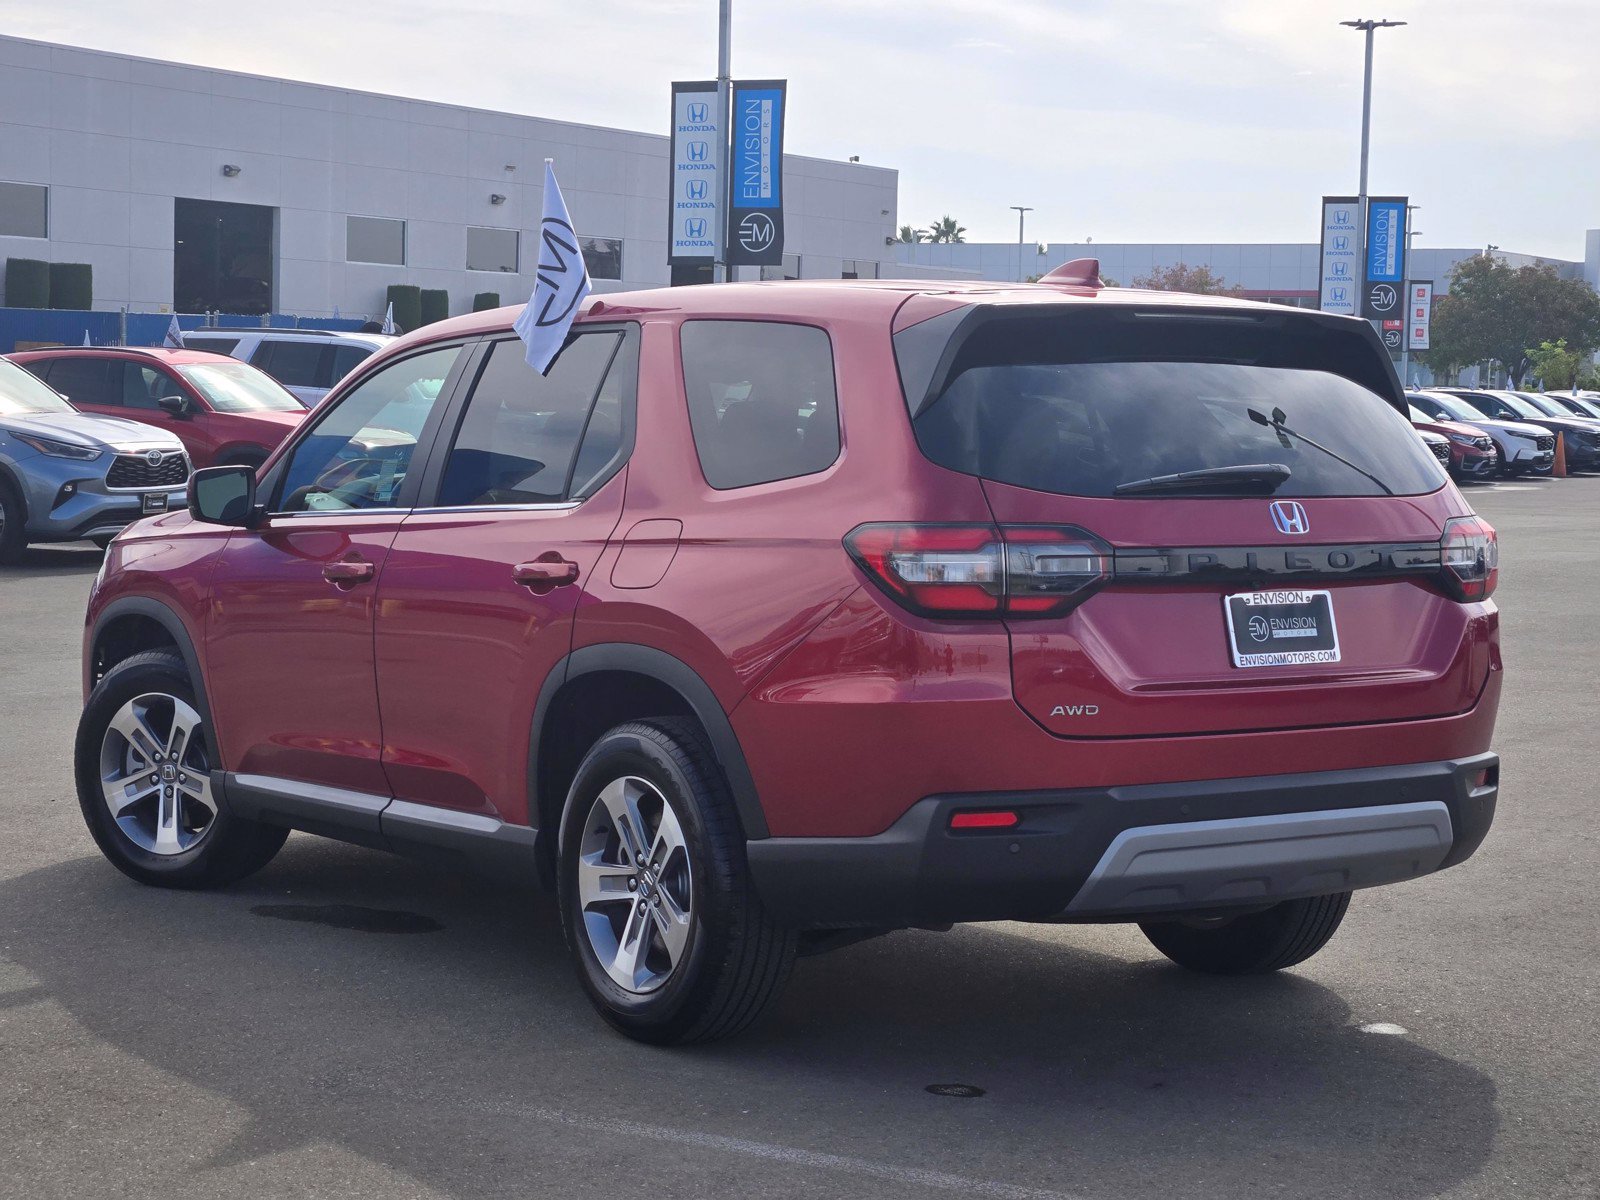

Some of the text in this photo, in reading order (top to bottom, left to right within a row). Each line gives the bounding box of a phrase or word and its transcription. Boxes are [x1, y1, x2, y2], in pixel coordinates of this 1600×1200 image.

[743, 99, 761, 199] ENVISION
[1373, 208, 1389, 276] ENVISION
[1189, 551, 1394, 573] PILOT
[1253, 592, 1303, 604] ENVISION
[1270, 617, 1316, 629] ENVISION
[1240, 651, 1336, 666] ENVISIONMOTORS.COM
[1050, 704, 1099, 717] AWD
